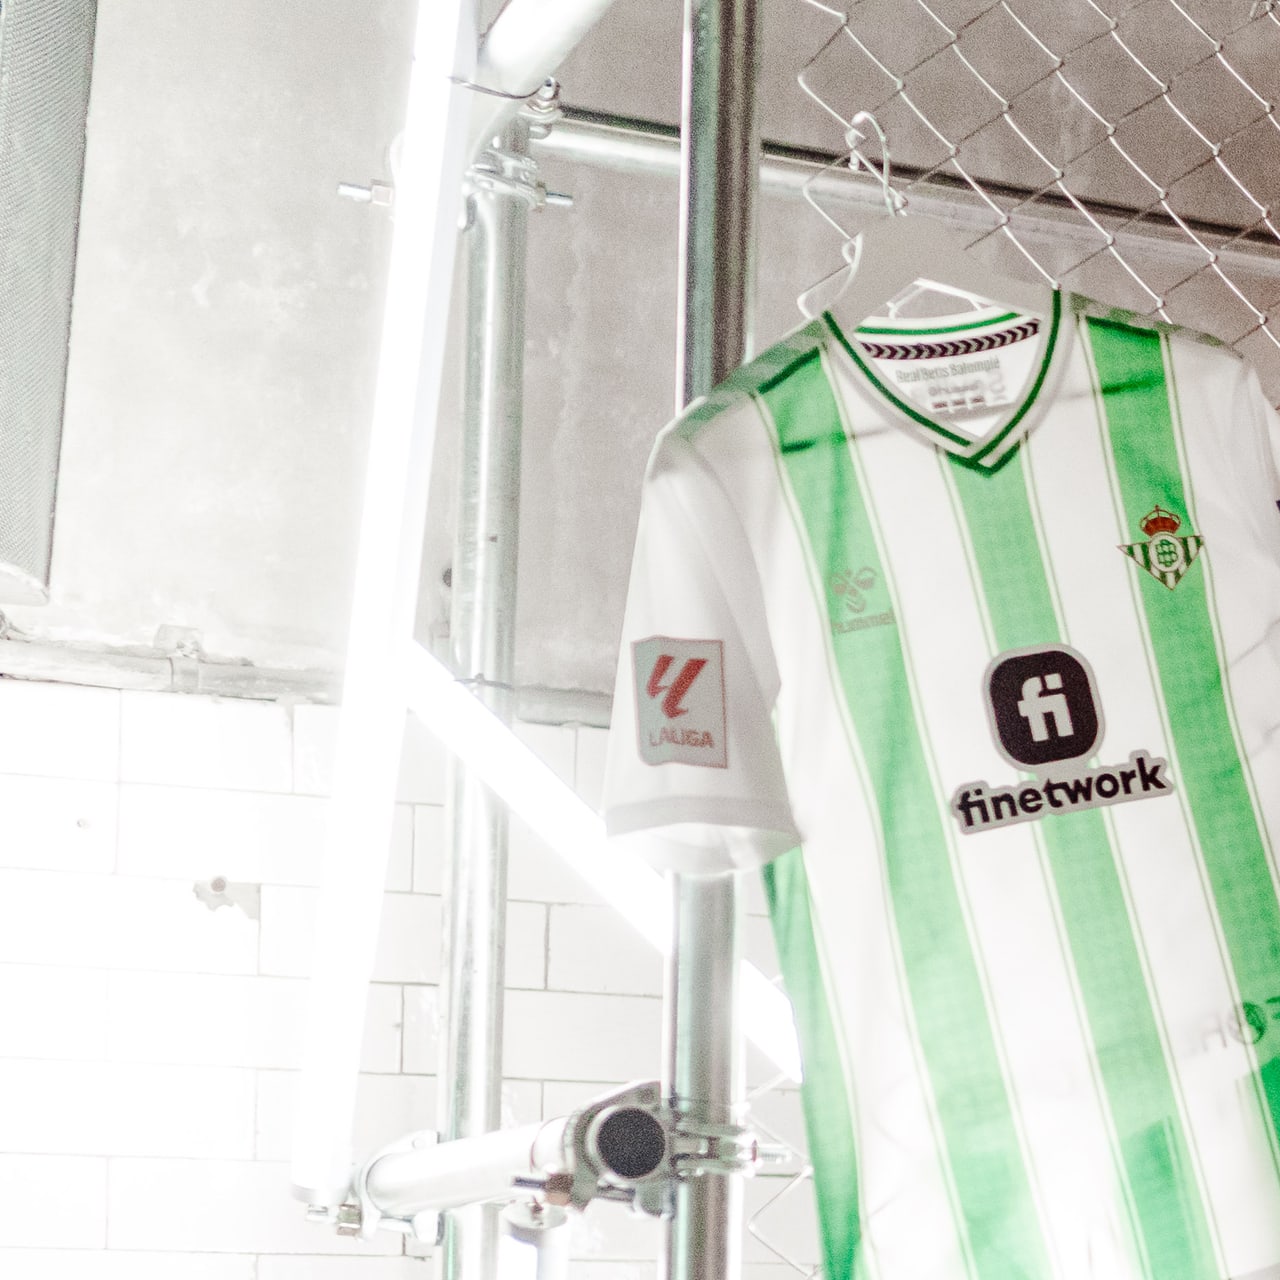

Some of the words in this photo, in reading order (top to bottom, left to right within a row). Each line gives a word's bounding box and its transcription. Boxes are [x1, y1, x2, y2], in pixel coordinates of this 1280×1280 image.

[648, 727, 715, 749] LALIGA
[1017, 672, 1075, 743] fi
[957, 756, 1168, 827] finetwork
